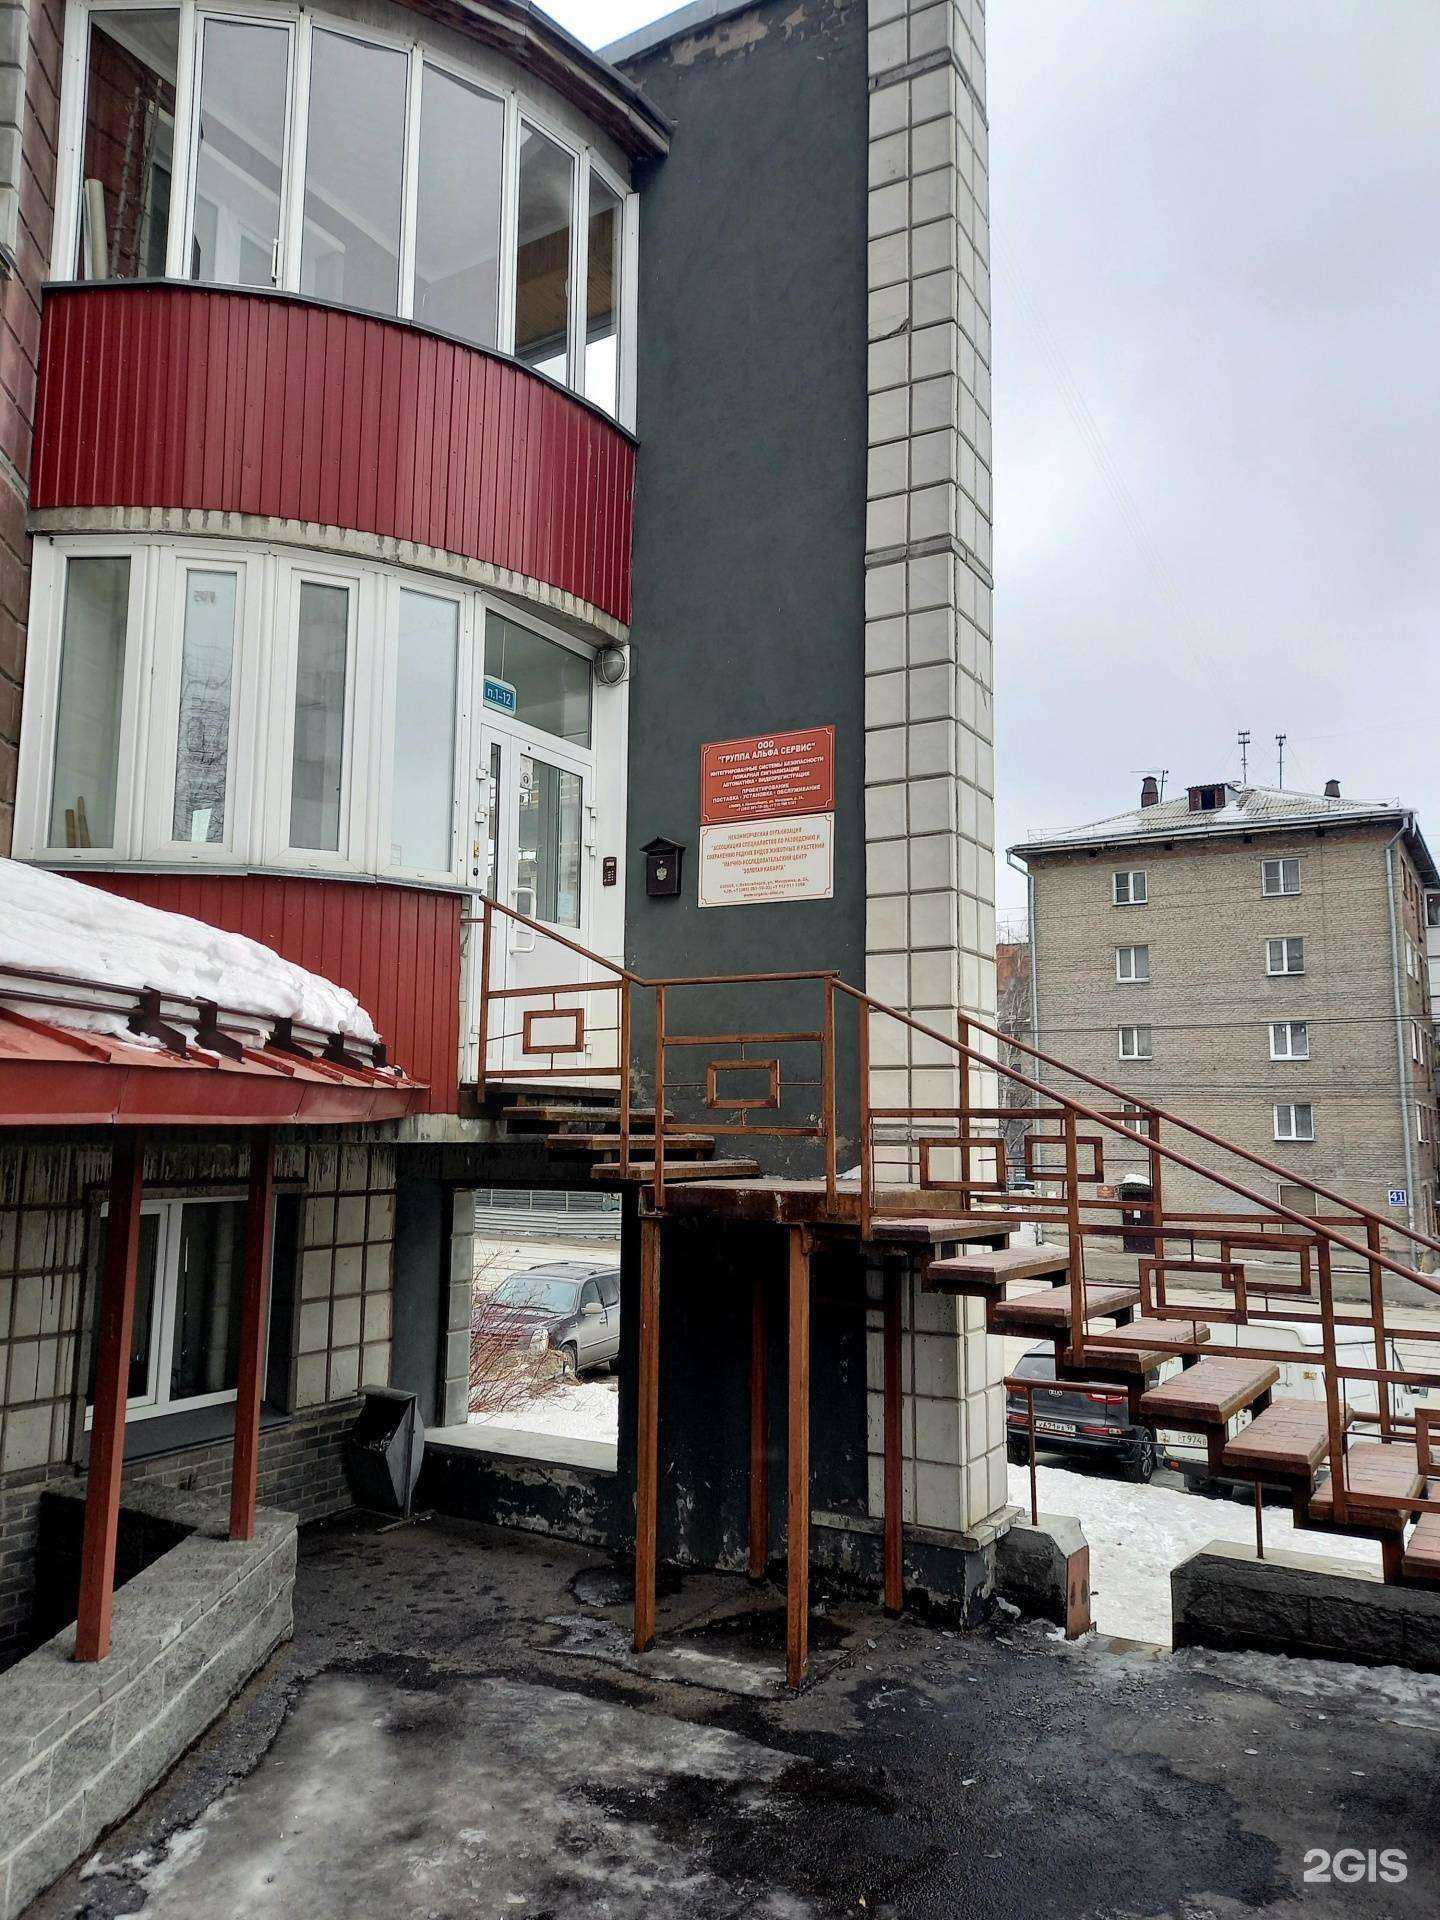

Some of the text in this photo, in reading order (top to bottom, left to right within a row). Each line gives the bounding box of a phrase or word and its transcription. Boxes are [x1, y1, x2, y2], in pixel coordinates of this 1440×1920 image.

[757, 740, 774, 750] ООО
[751, 748, 779, 760] АЛЬФА
[1391, 1192, 1404, 1201] 41
